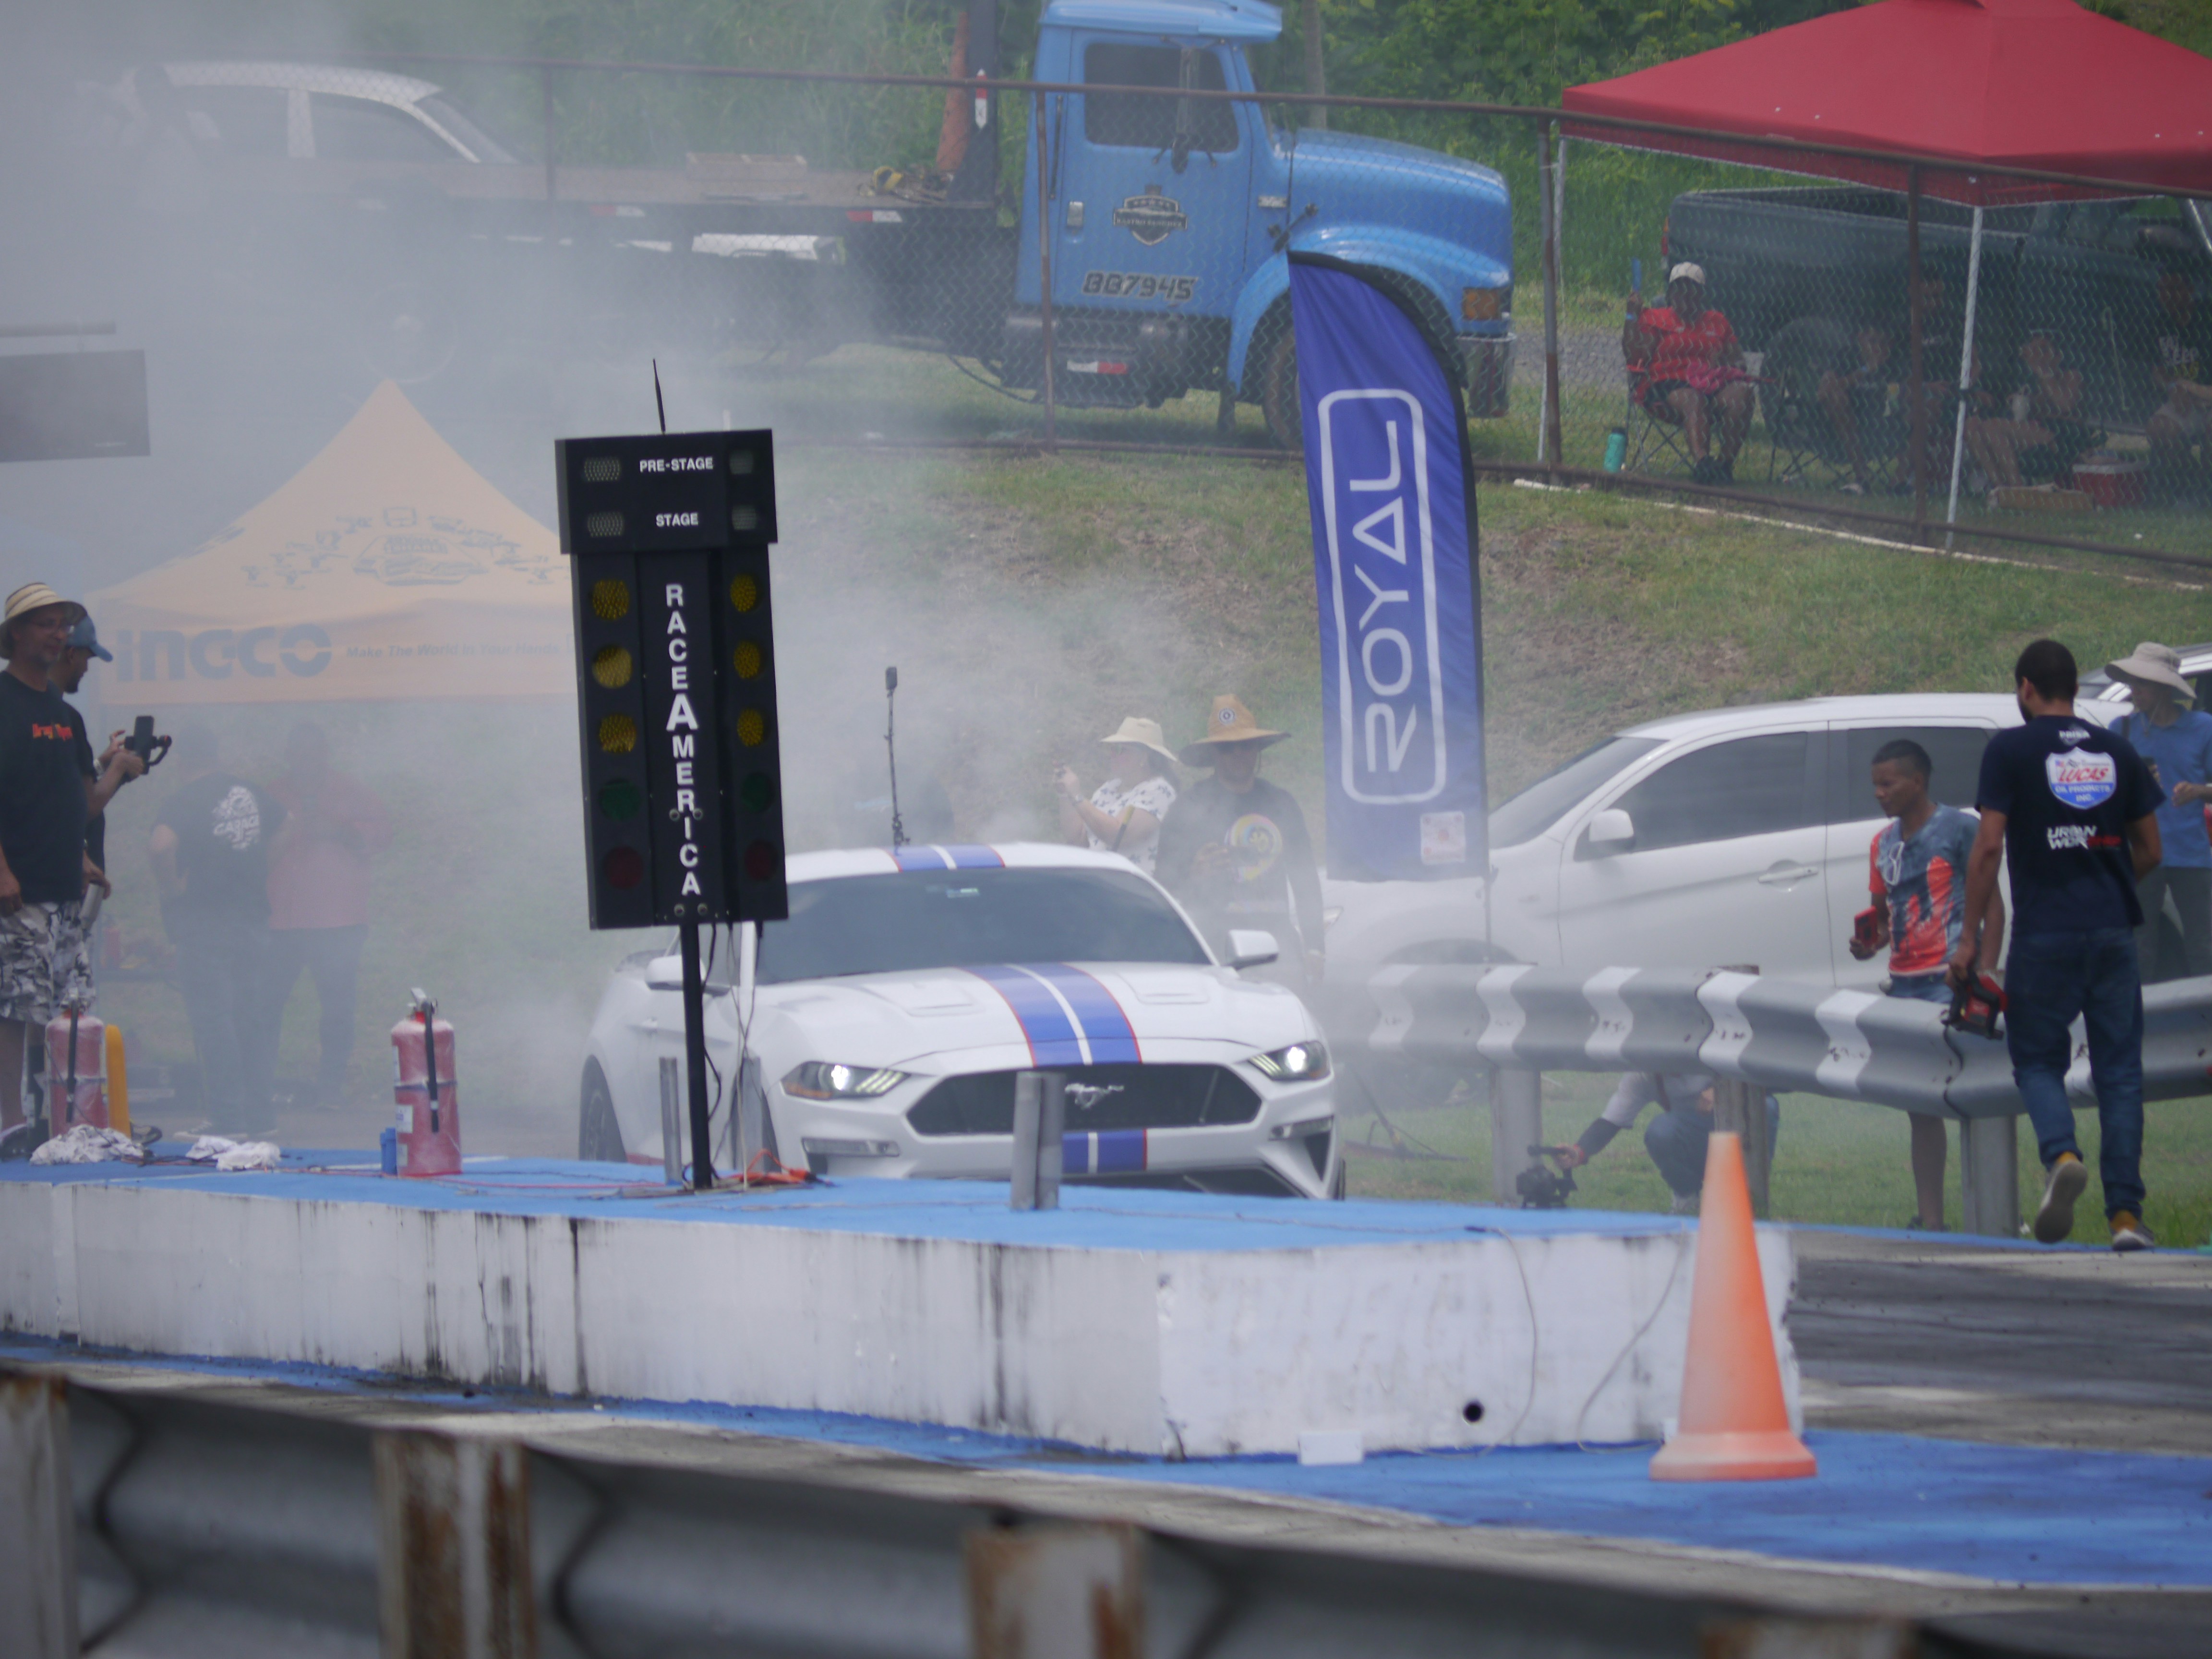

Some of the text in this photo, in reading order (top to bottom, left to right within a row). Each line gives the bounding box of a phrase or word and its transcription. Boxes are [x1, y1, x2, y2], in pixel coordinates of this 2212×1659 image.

[639, 457, 713, 473] PRE-STAGE
[656, 512, 699, 527] STAGE
[1349, 420, 1418, 772] ROYAL
[346, 647, 383, 658] Make
[388, 645, 413, 657] The
[417, 643, 458, 657] World
[2058, 768, 2109, 783] LUCAS
